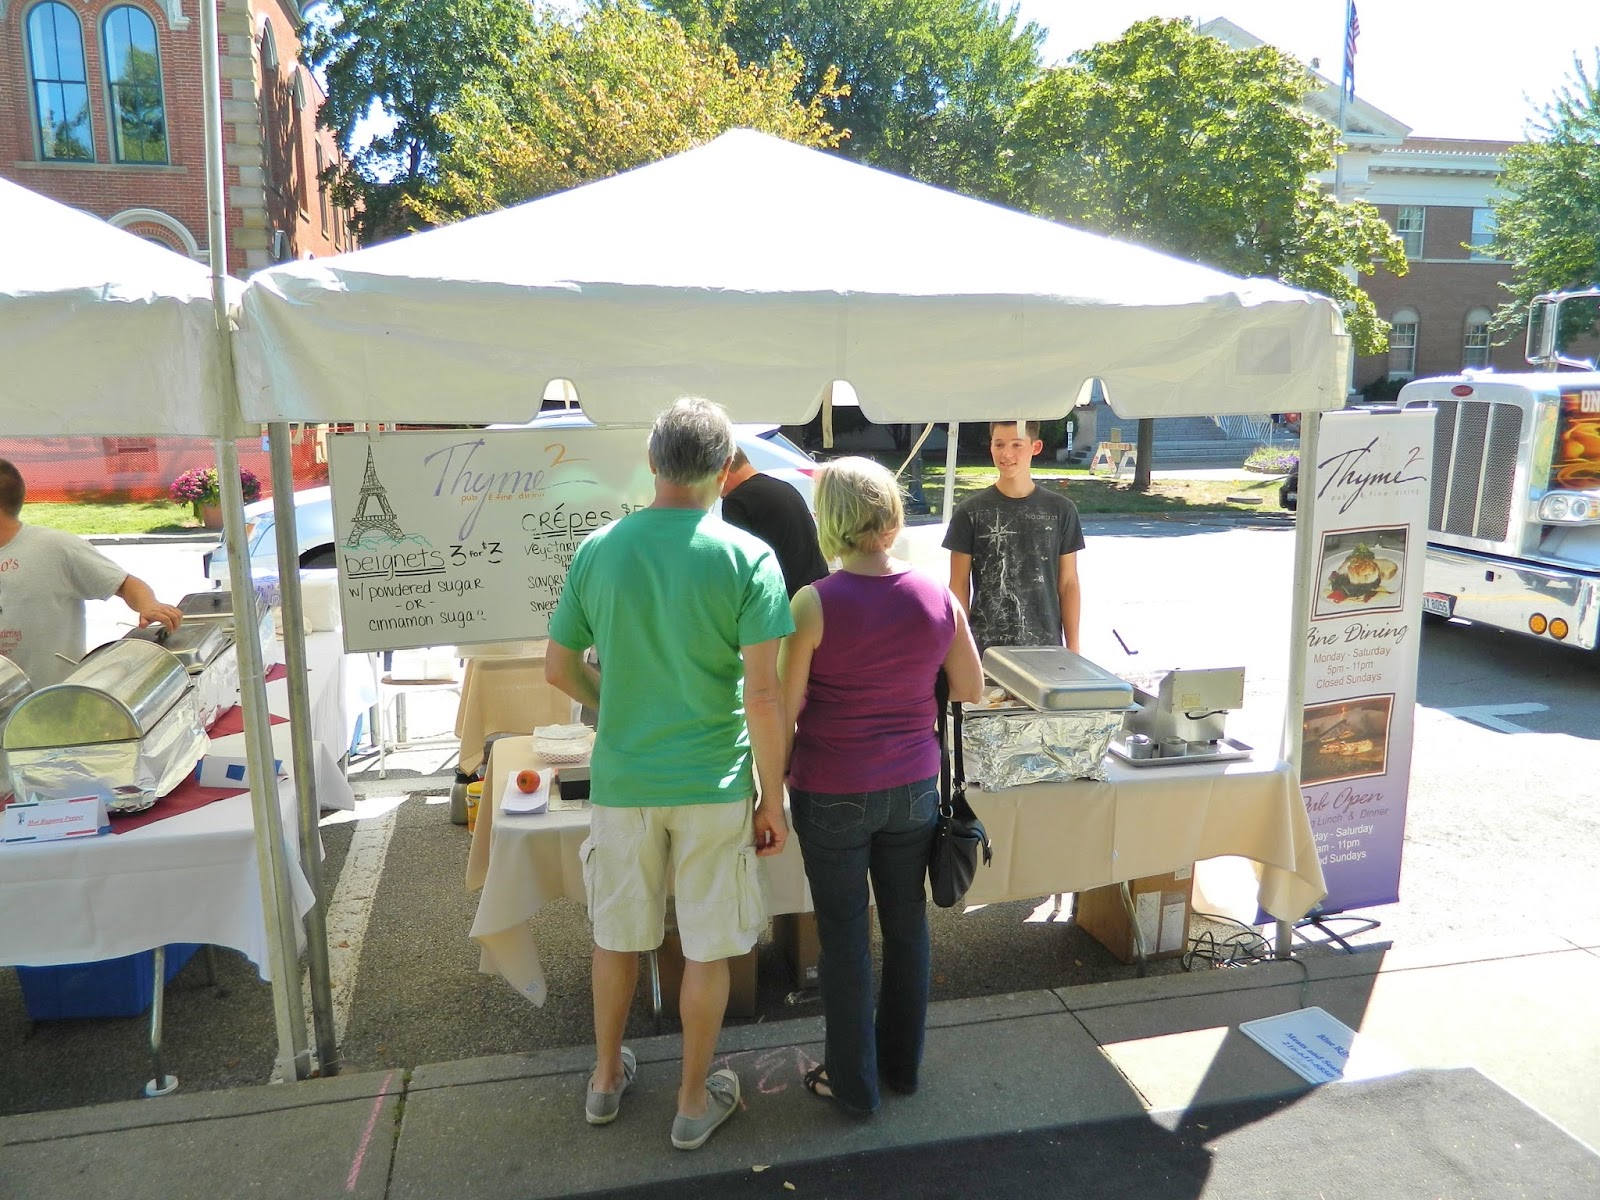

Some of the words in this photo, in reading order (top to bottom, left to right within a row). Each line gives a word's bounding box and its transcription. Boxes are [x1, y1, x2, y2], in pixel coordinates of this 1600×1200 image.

[1317, 436, 1427, 515] Thyme
[461, 495, 478, 507] pub
[1331, 494, 1347, 502] pub
[1394, 488, 1420, 496] dining
[344, 549, 446, 582] beignets
[368, 579, 432, 602] powdered
[368, 615, 434, 631] cinnamon
[1344, 621, 1409, 645] Dining
[1313, 652, 1346, 664] Monday
[1352, 645, 1392, 659] Saturday
[1326, 664, 1345, 675] 5pm
[1352, 661, 1374, 672] 11pm
[1316, 676, 1344, 689] Closed
[1345, 673, 1382, 685] Sundays
[1332, 786, 1385, 814] Open
[1317, 814, 1343, 826] Lunch
[1347, 811, 1354, 821] &
[1360, 807, 1389, 819] Dinner
[1335, 824, 1374, 838] Saturday
[1337, 839, 1360, 850] 11pm
[1329, 850, 1367, 864] Sundays
